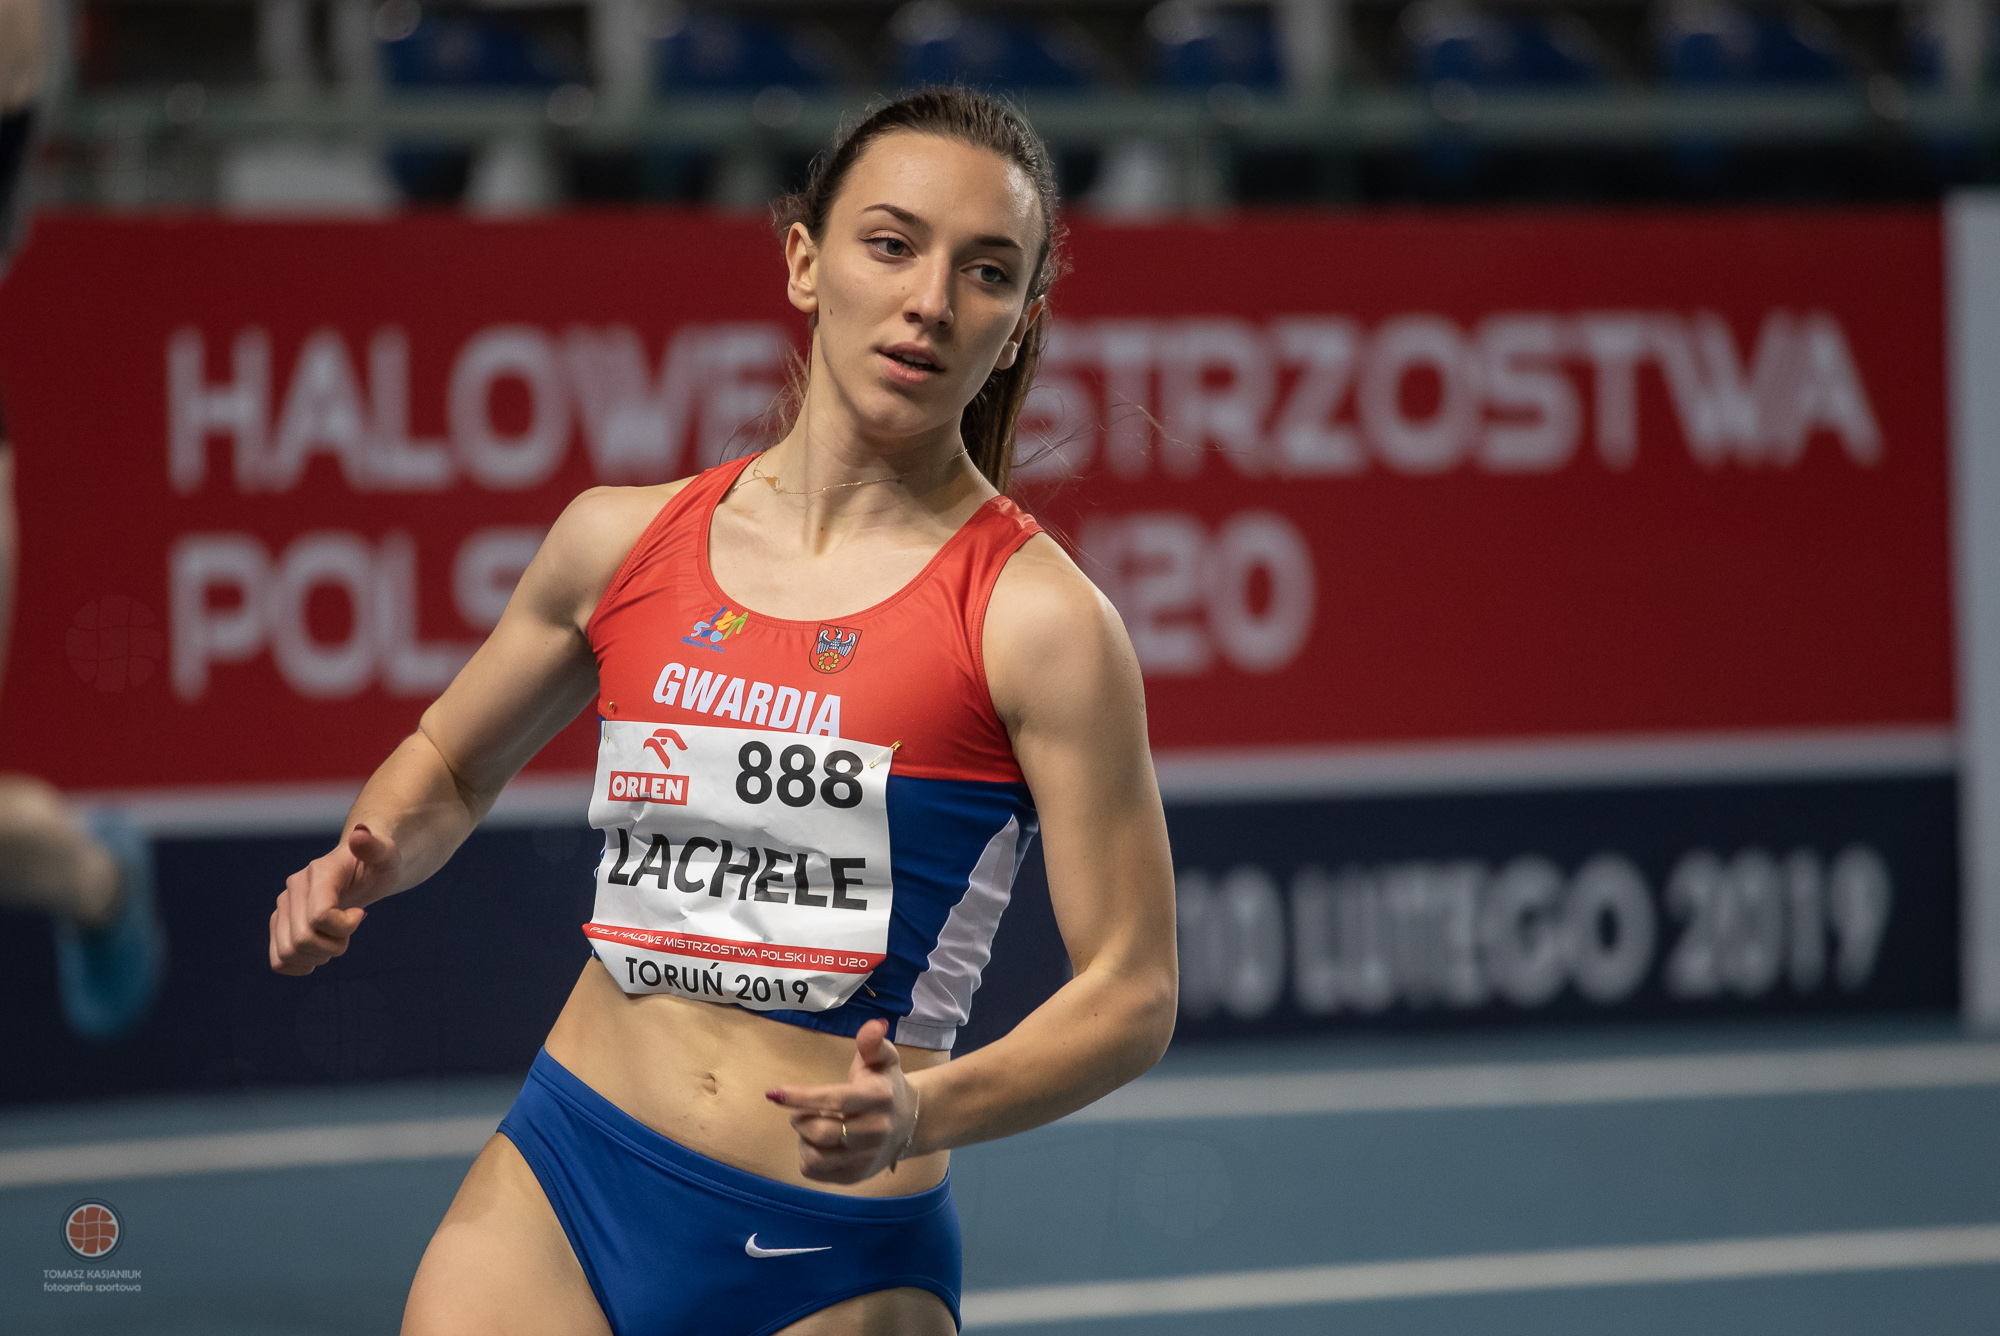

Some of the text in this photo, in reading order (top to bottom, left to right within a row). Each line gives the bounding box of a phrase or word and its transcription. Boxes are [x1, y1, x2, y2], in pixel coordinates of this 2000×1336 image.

[1012, 308, 1884, 480] STRZOSTWA
[167, 526, 550, 700] POL
[652, 662, 842, 738] GWARDIA
[611, 774, 684, 801] ORLEN
[735, 740, 864, 809] 888
[607, 827, 868, 911] LACHELE
[589, 926, 869, 969] PZLA HALOWE MISTRZOSTWA POLSKI U18 U20
[1662, 844, 1892, 999] 2019
[625, 956, 809, 1004] TORUŃ 2019
